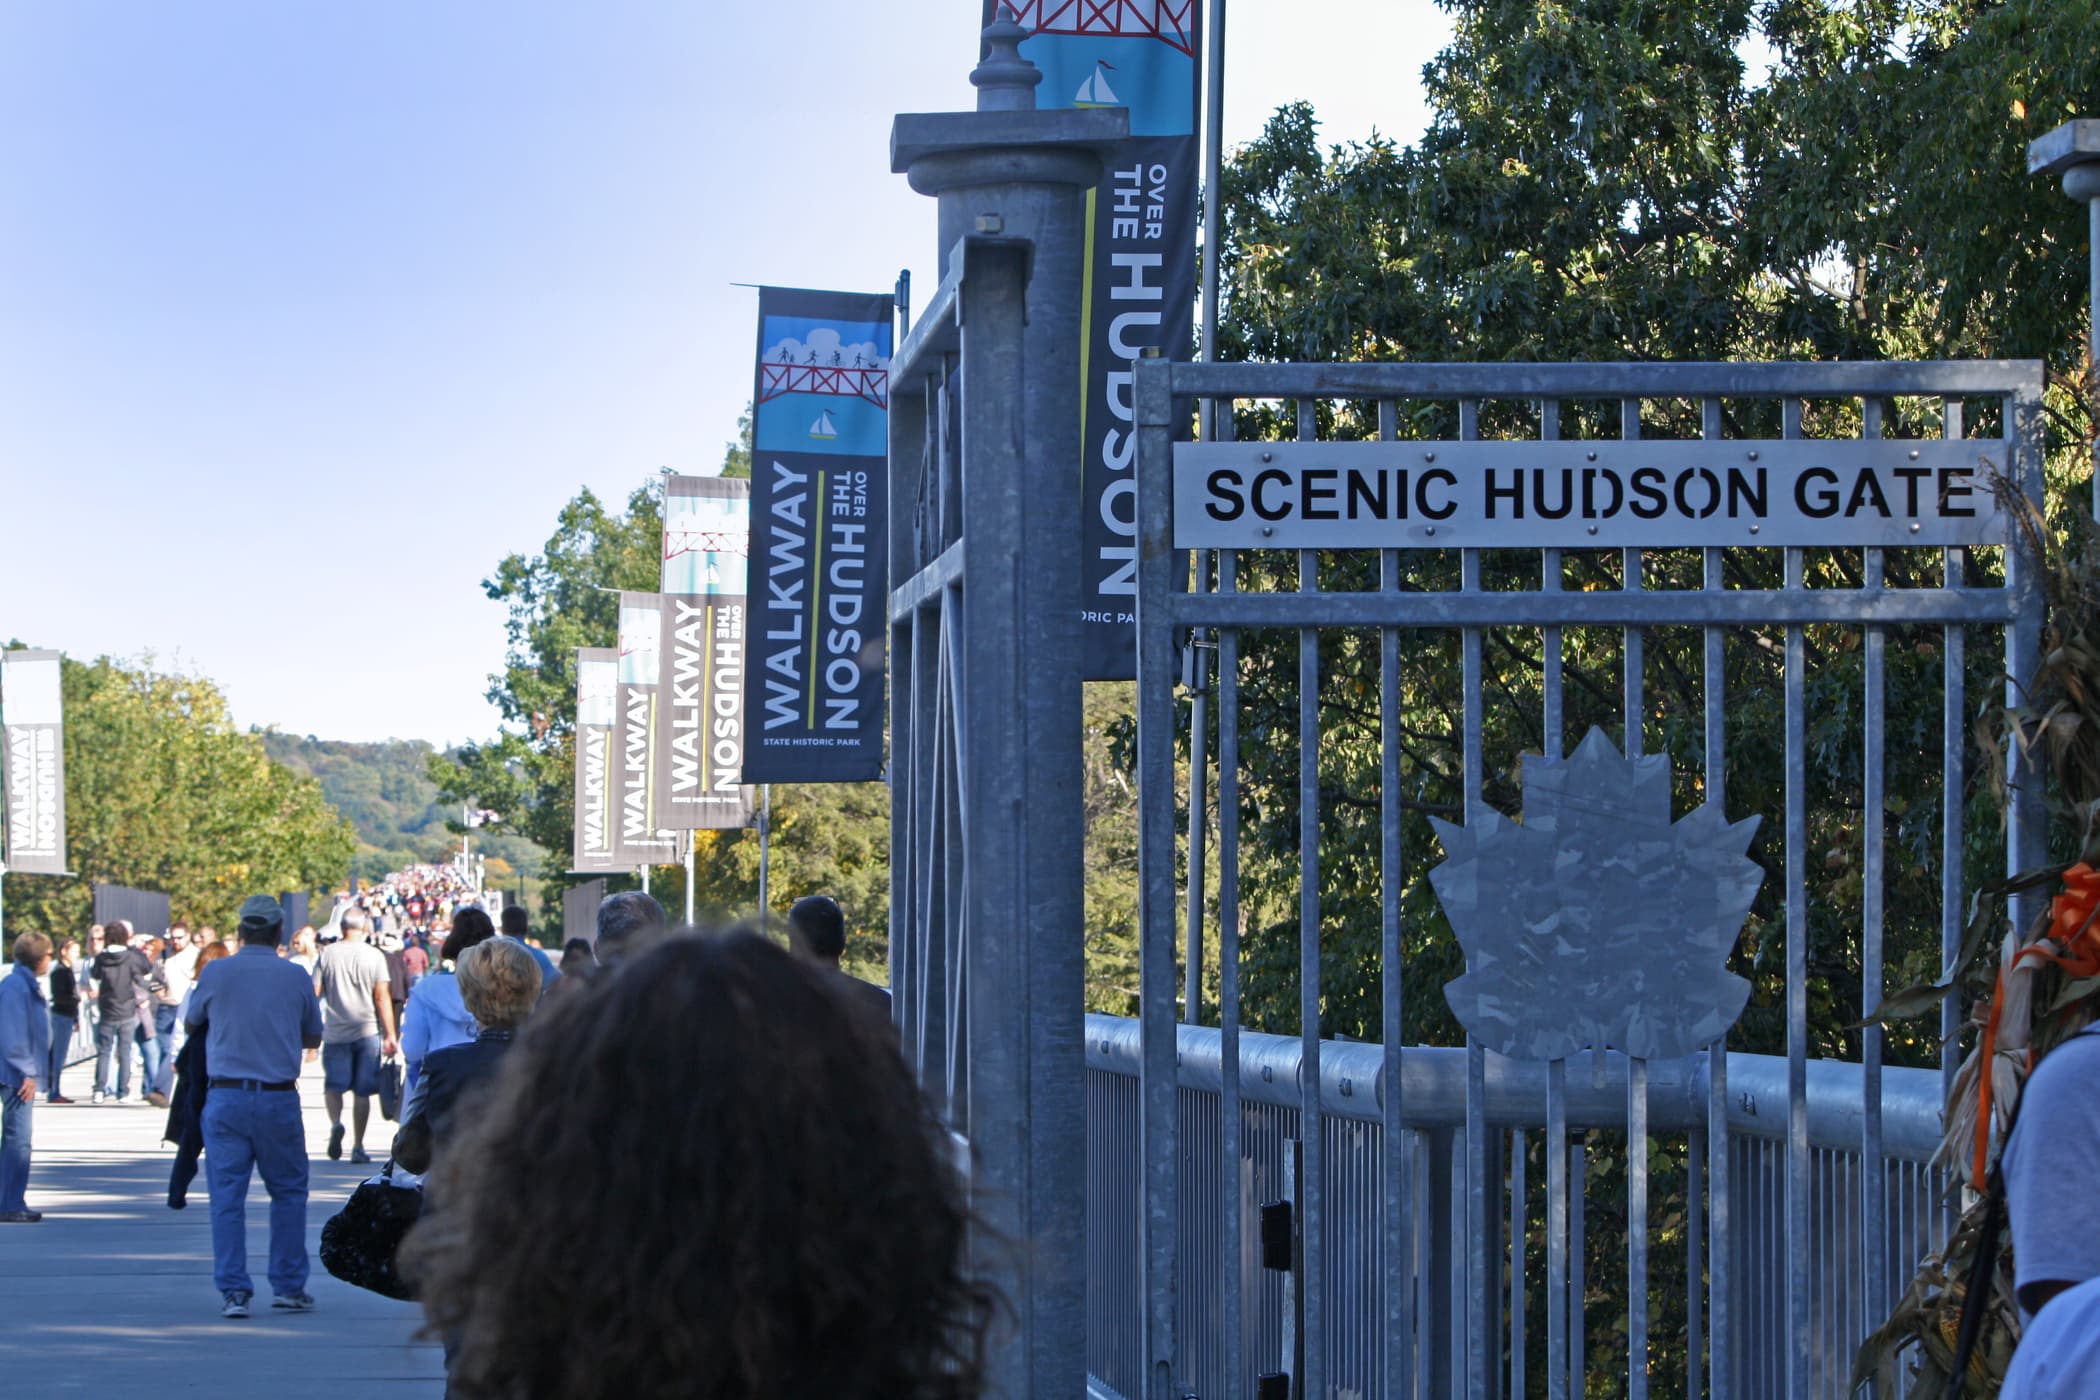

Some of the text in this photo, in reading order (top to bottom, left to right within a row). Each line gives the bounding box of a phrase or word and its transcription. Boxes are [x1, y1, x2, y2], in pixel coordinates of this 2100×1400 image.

[1112, 163, 1142, 239] THE
[1144, 164, 1167, 239] OVER
[853, 471, 867, 517] OVER
[1204, 467, 1976, 521] SCENIC HUDSON GATE
[764, 461, 808, 730] WALKWAY
[825, 470, 866, 730] THE HUDSON
[672, 600, 701, 792] WALKWAY
[713, 605, 741, 791] THE HUDSON
[764, 738, 860, 746] STATE HISTORIC PARK
[10, 726, 30, 849] WALKWAY
[584, 726, 605, 850] WALKWAY
[624, 687, 648, 837] WALKWAY
